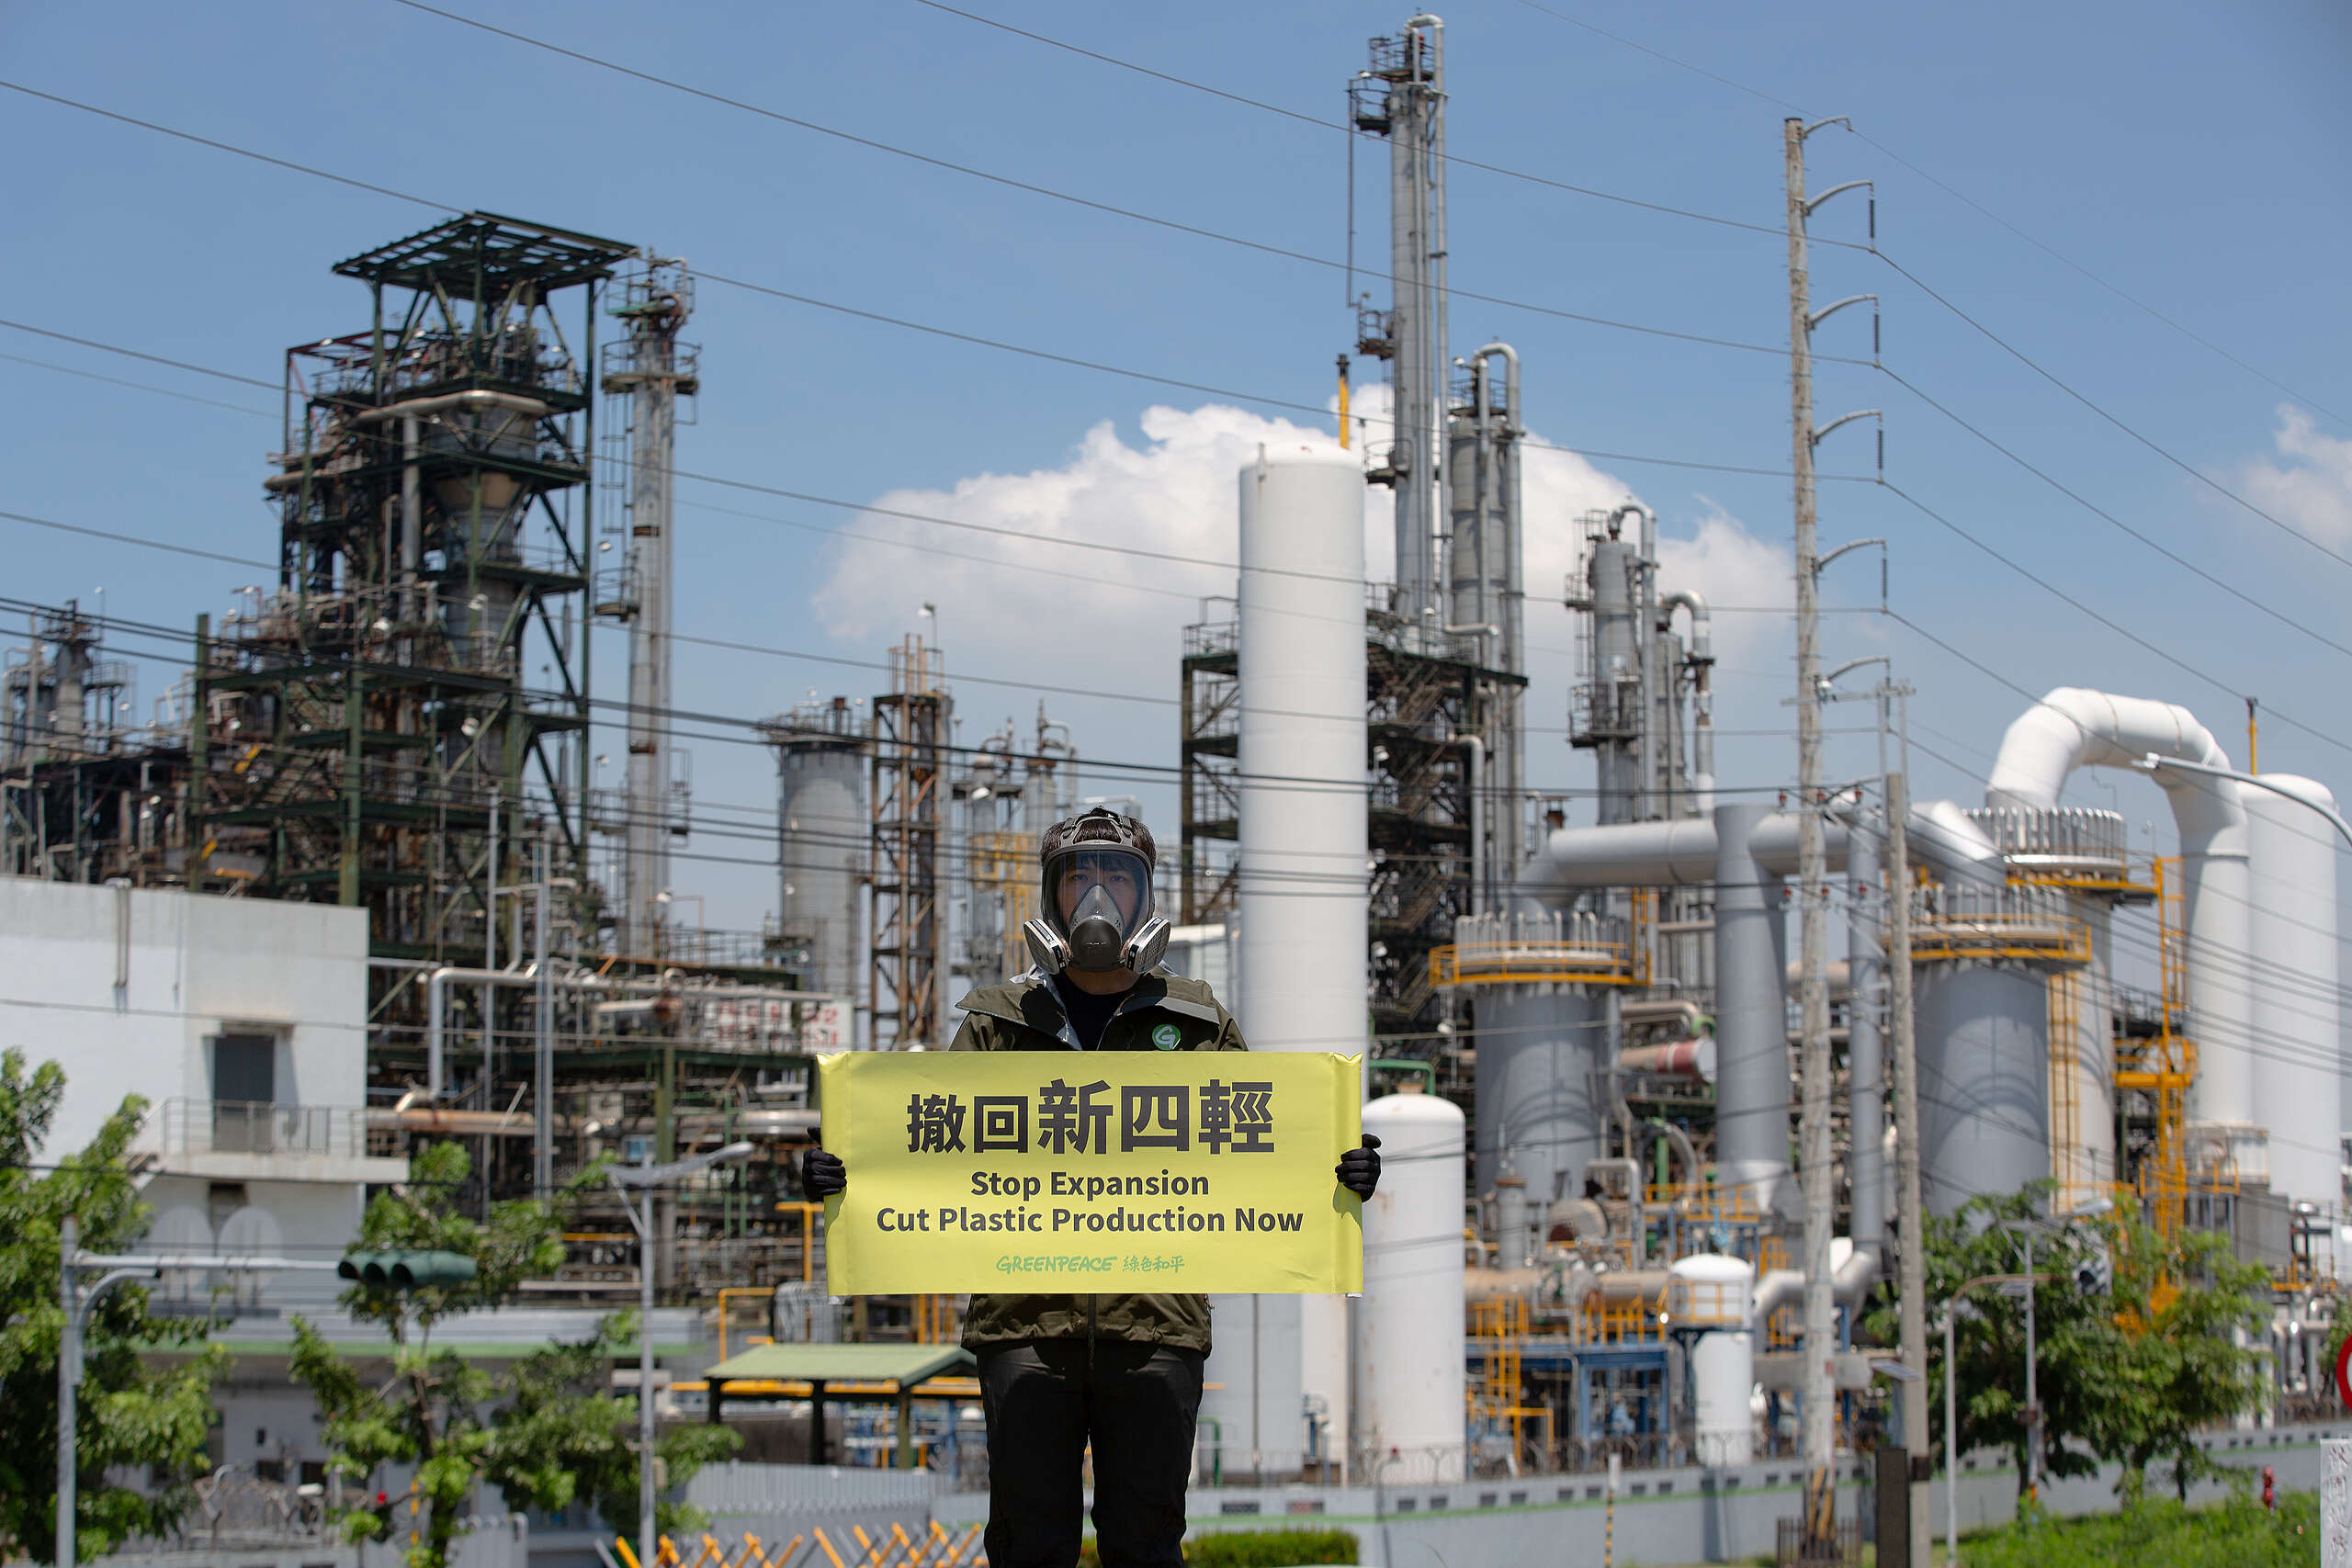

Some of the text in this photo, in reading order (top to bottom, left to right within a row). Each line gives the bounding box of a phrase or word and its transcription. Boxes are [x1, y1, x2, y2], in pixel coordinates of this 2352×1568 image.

[1155, 1025, 1176, 1050] G
[906, 1077, 1275, 1156] 撤回新四輕
[970, 1168, 1210, 1202] Stop Expansion
[876, 1205, 1305, 1233] Cut Plastic Production Now
[995, 1255, 1185, 1275] GREENPEACE 綠色和平
